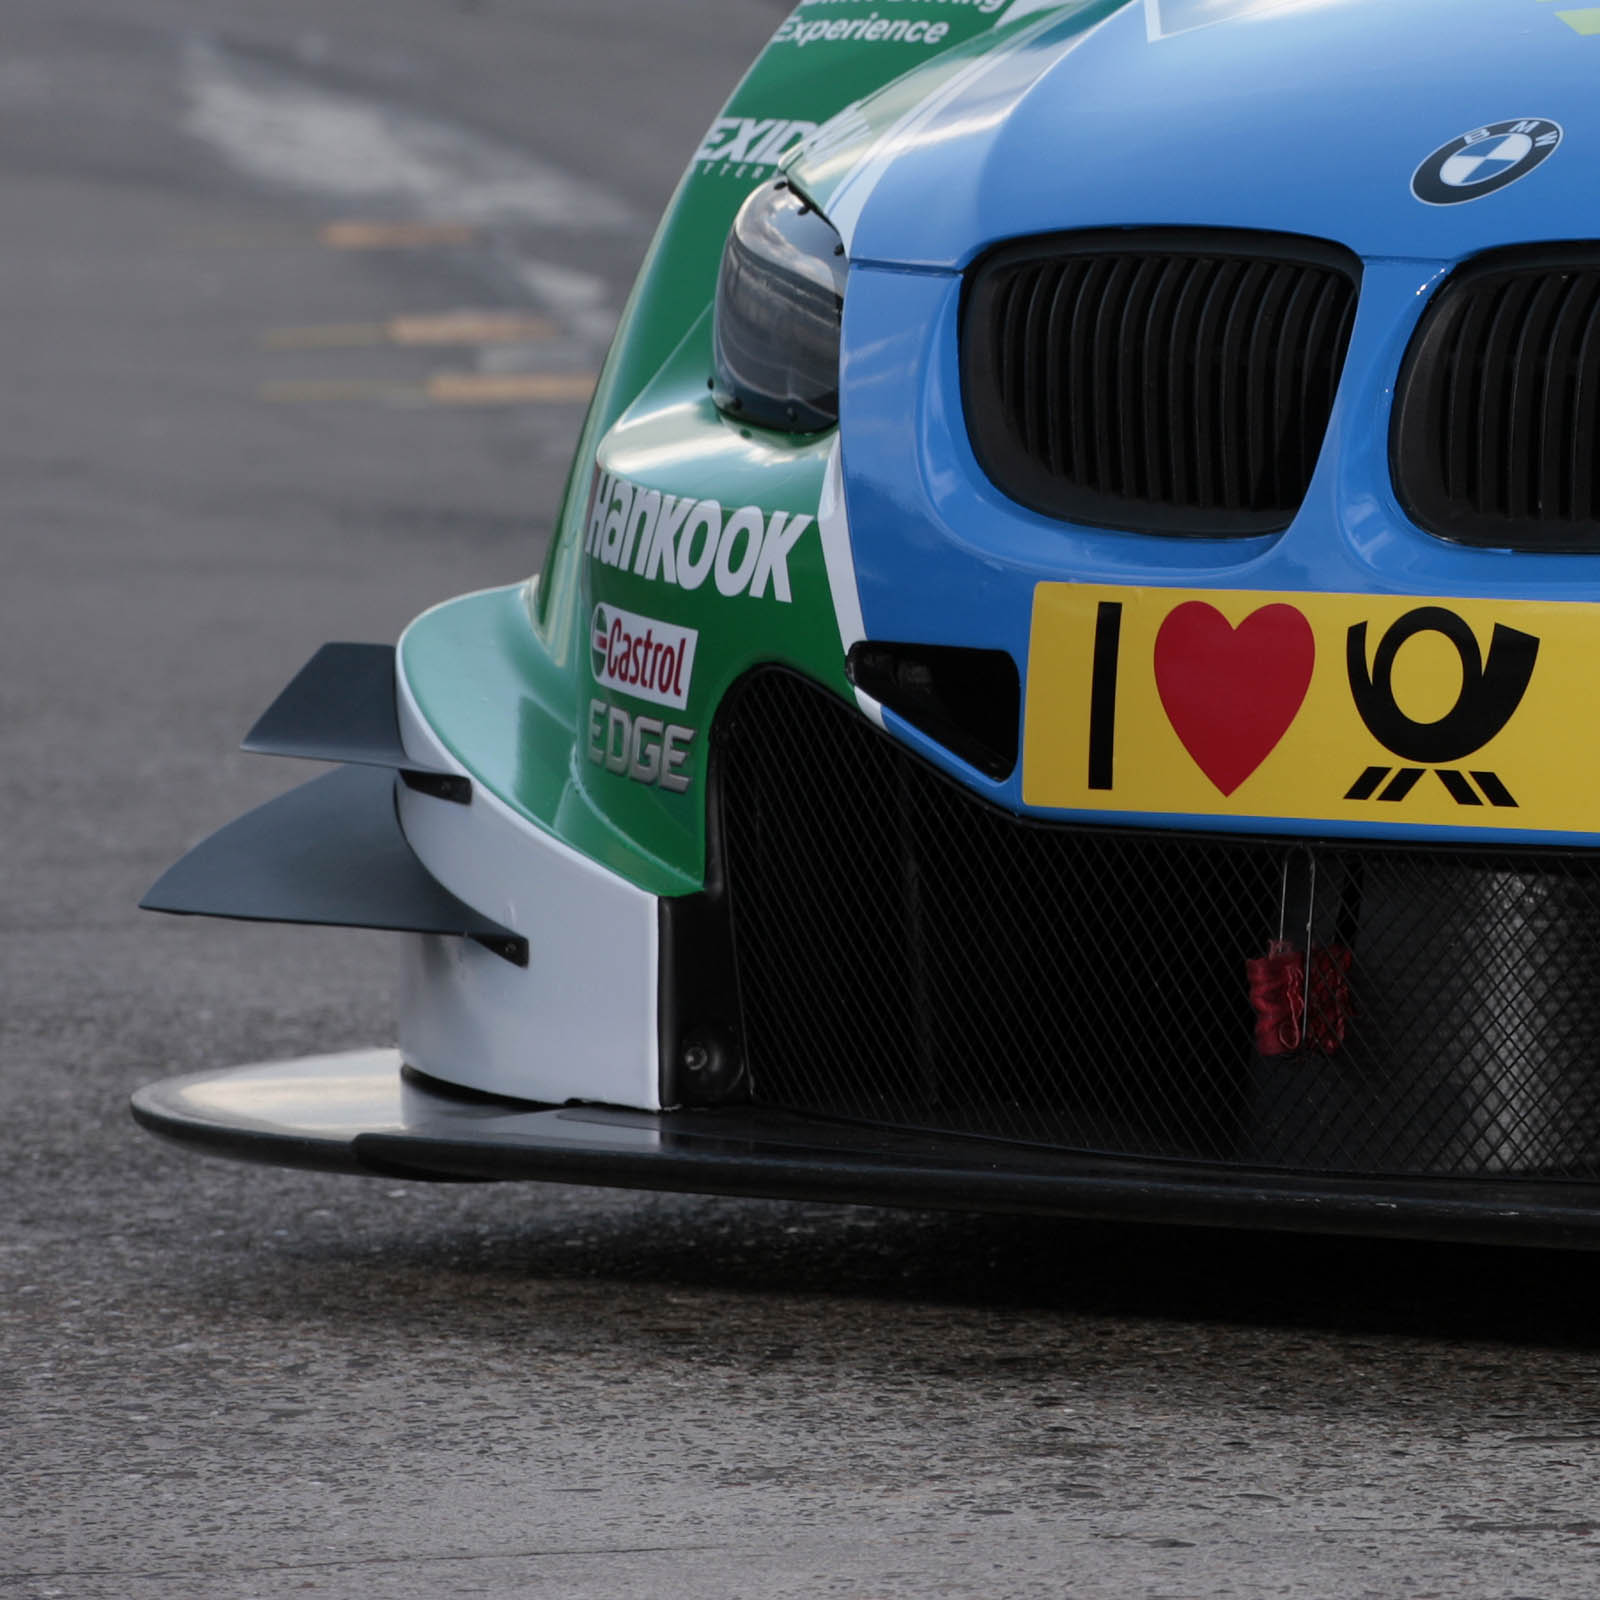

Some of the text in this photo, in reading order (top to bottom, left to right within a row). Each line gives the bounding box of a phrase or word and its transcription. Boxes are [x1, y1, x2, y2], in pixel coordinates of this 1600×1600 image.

[771, 12, 950, 47] Experience
[696, 117, 819, 165] EXID
[607, 617, 687, 697] Castrol
[589, 698, 697, 794] EDGE
